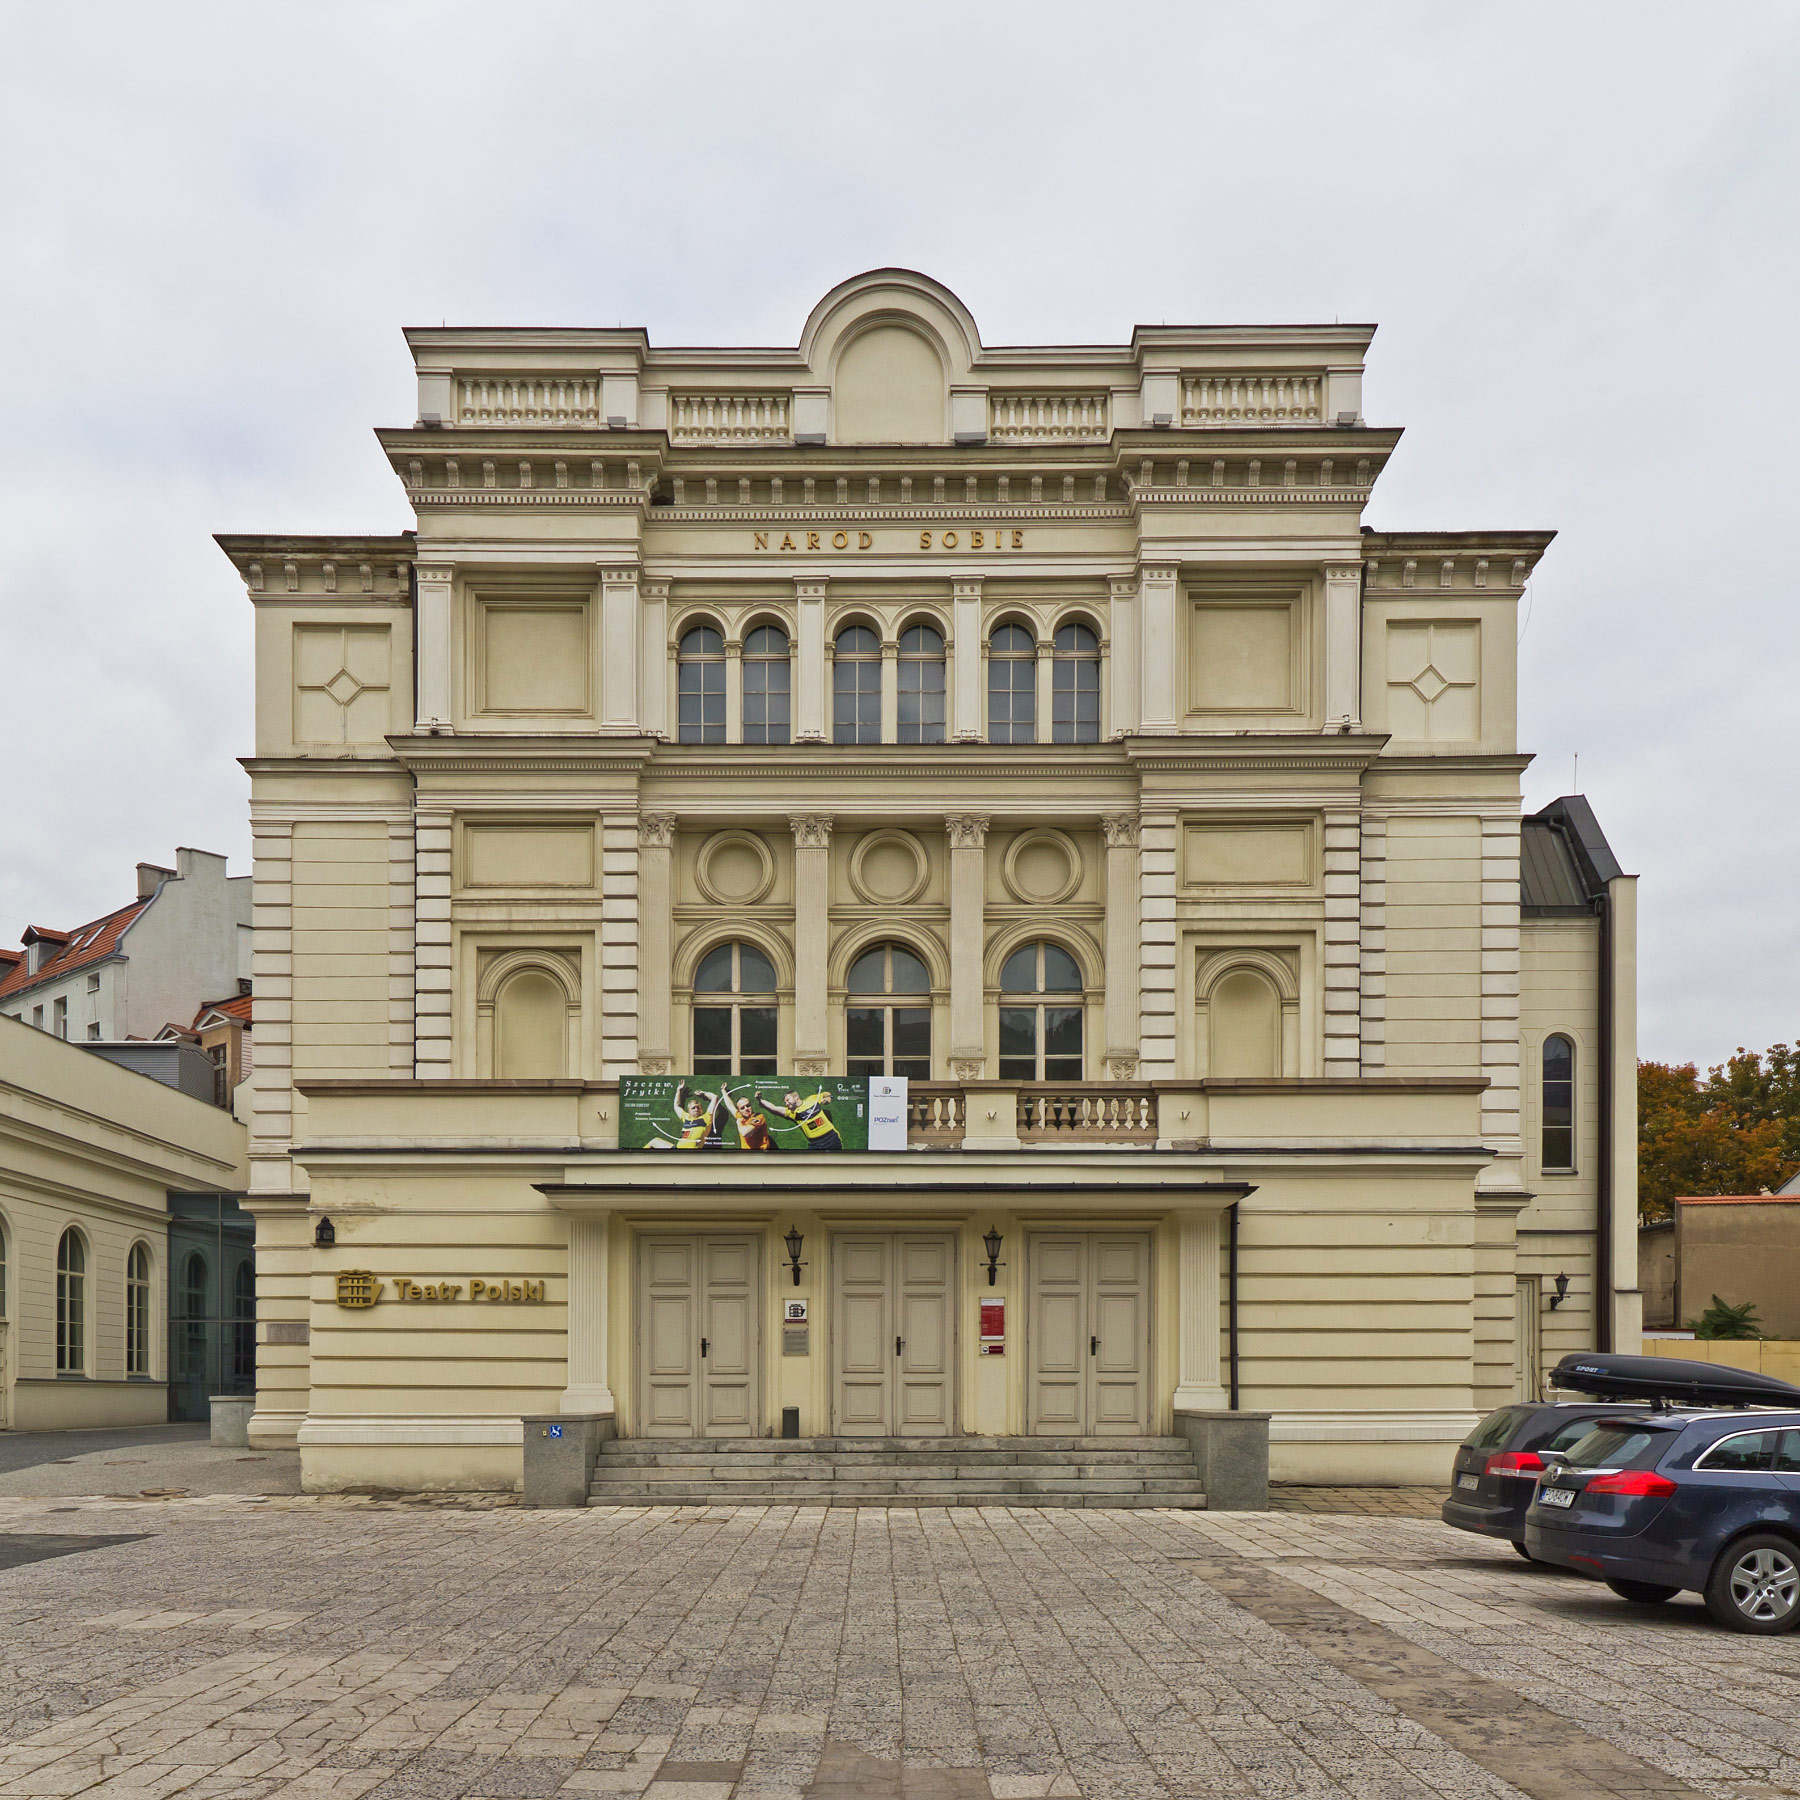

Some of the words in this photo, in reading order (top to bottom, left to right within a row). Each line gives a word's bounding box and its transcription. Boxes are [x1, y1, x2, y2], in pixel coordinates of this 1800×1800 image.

[753, 529, 873, 550] NARÓD
[919, 529, 1024, 549] SOBIE
[625, 1080, 674, 1088] Szczaw,
[623, 1088, 667, 1097] frytki
[392, 1278, 462, 1300] Teatr
[469, 1279, 546, 1301] Polski
[1575, 1365, 1599, 1373] SPORT
